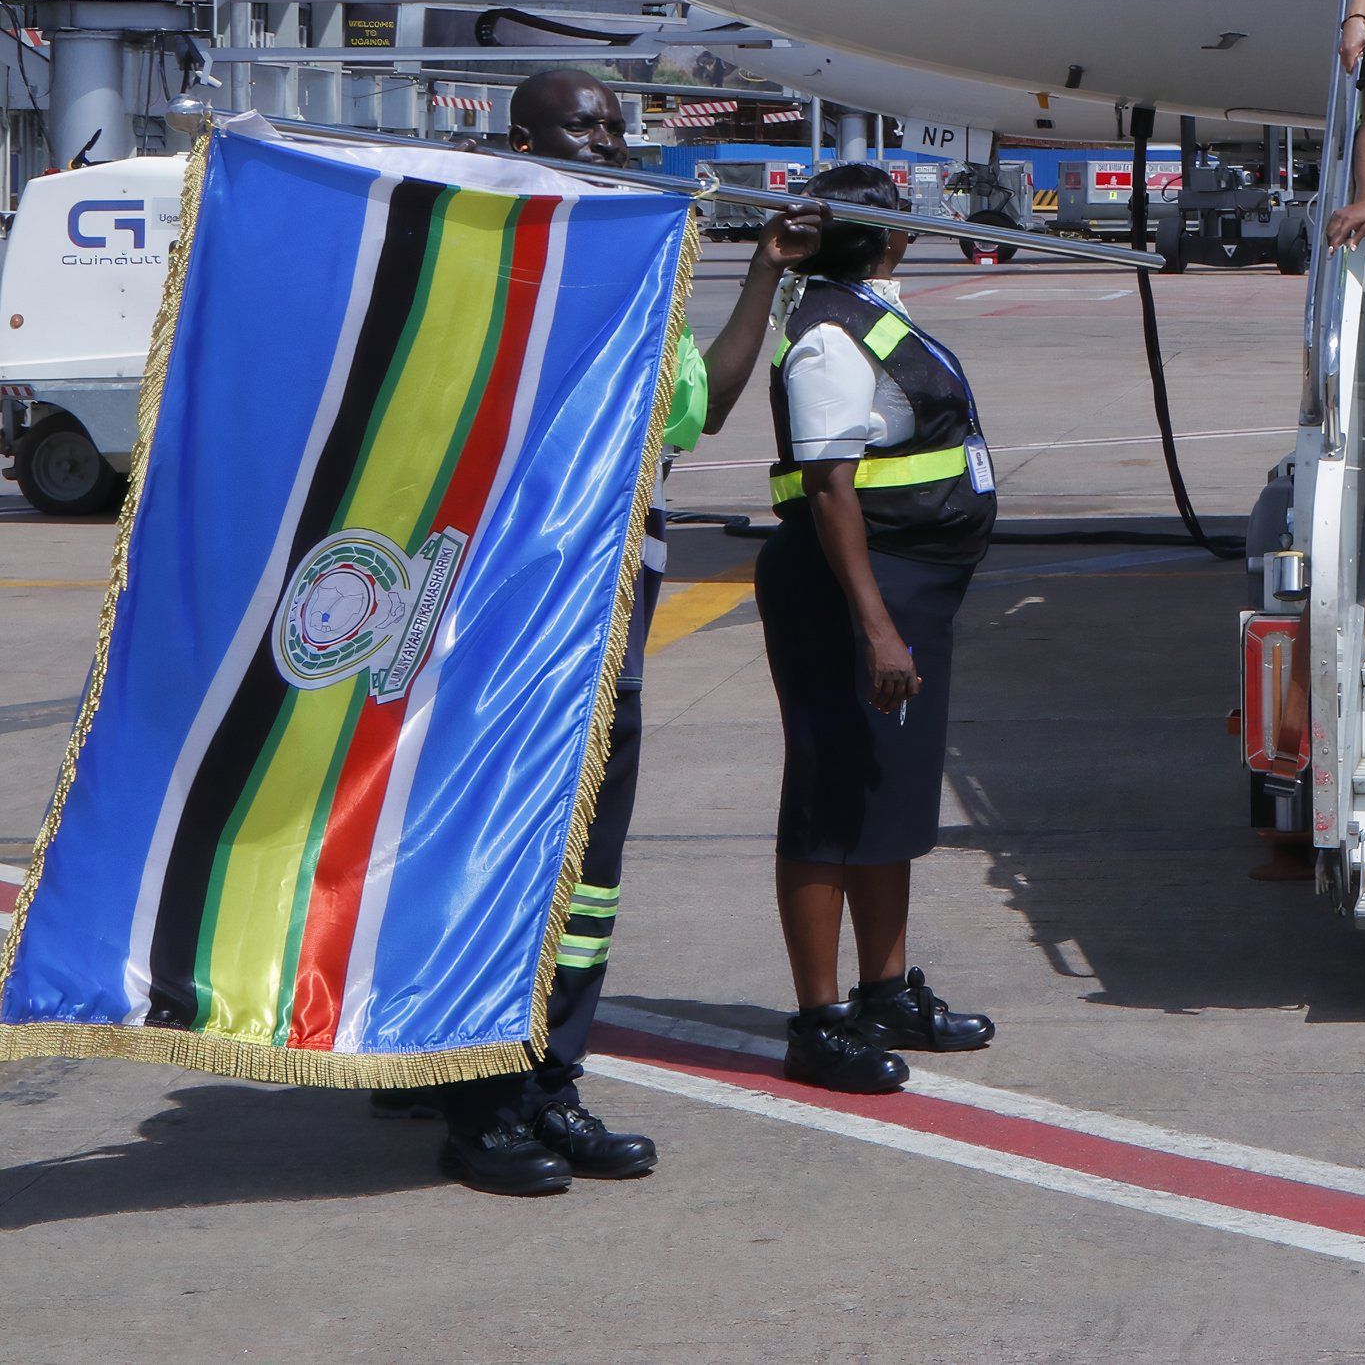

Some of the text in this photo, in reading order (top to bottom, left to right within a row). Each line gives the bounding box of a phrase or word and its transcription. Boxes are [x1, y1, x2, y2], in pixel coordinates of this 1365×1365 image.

[348, 20, 395, 28] WELCOME
[351, 38, 390, 46] UGANDA
[922, 126, 954, 148] NP
[61, 255, 162, 265] Guinault
